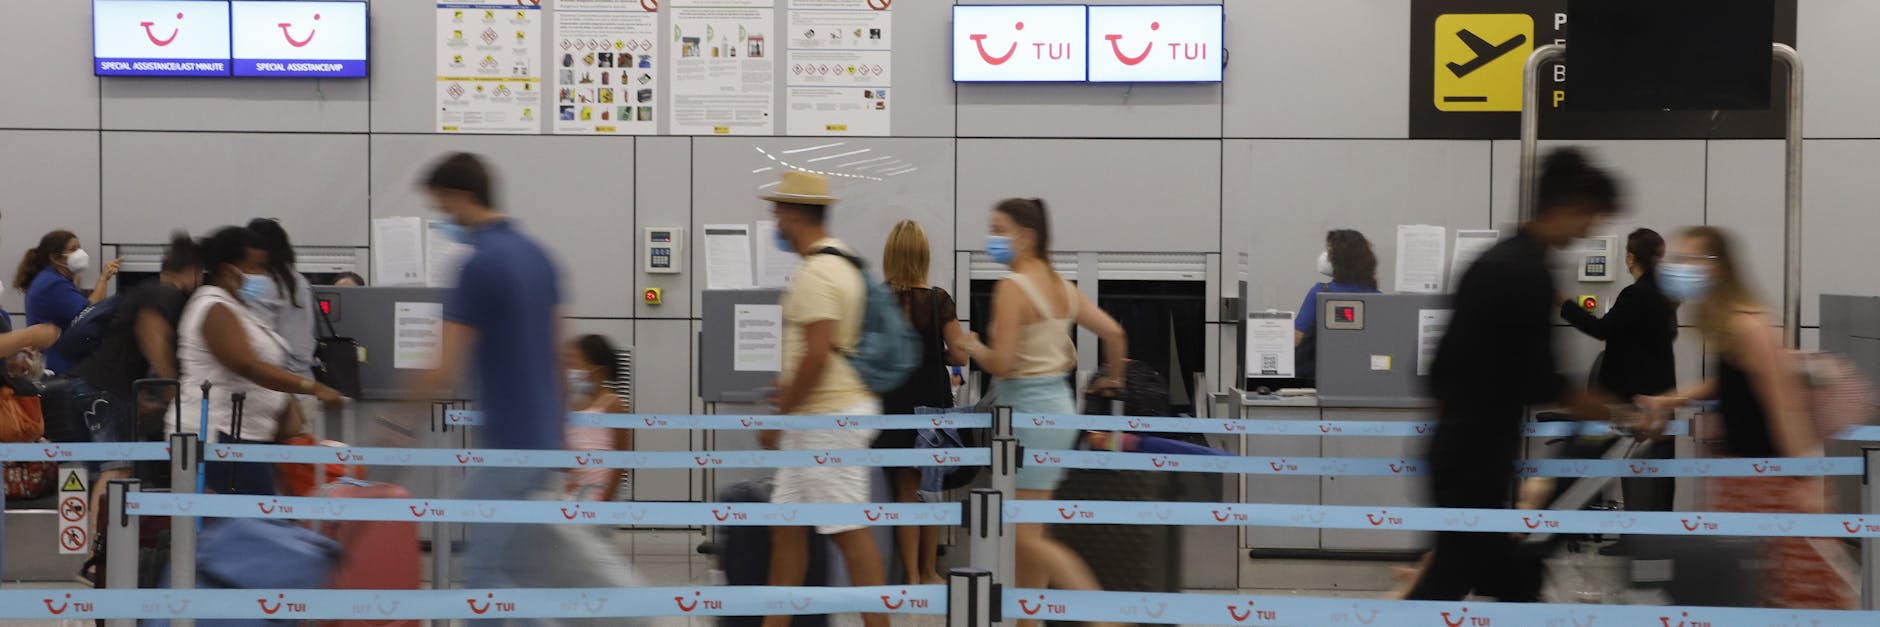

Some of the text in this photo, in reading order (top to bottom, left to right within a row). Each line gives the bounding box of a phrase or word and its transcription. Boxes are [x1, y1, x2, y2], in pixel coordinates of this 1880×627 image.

[1032, 42, 1071, 60] TUI
[1168, 42, 1207, 60] TUI
[101, 61, 131, 71] SPECIAL
[195, 62, 225, 72] MINUTE
[256, 62, 344, 72] SPECIAL ASSISTANCE/VIP
[733, 512, 748, 520] TUI
[885, 512, 900, 520] TUI
[1079, 511, 1095, 519] TUI
[1388, 517, 1404, 525] TUI
[1545, 520, 1560, 528] TUI
[1703, 522, 1719, 530] TUI
[73, 602, 94, 612] TUI
[286, 602, 307, 613] TUI
[495, 602, 516, 612] TUI
[703, 600, 724, 611] TUI
[909, 599, 929, 609] TUI
[1047, 604, 1067, 614] TUI
[1256, 610, 1277, 620] TUI
[1471, 616, 1491, 627] TUI
